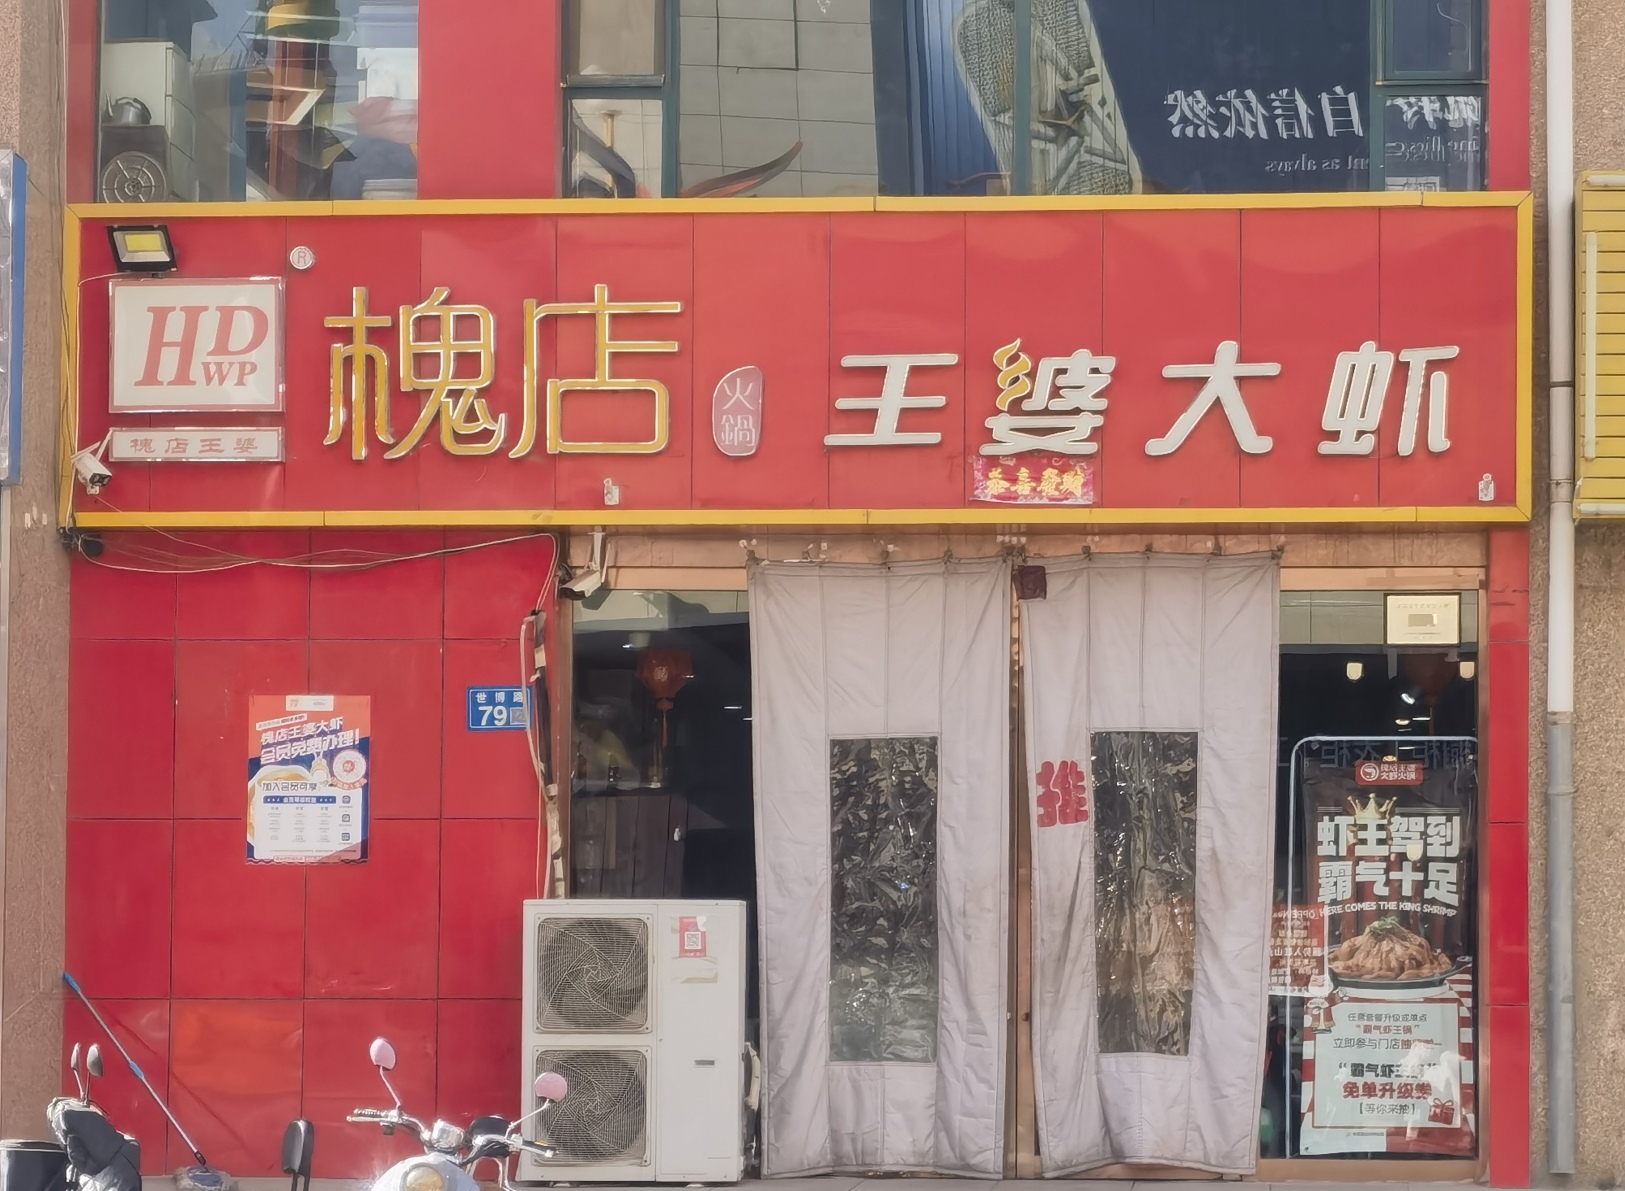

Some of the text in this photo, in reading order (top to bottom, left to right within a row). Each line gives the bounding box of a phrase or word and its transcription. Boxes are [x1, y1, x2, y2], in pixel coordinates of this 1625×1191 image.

[134, 304, 269, 388] HD
[201, 361, 258, 388] WP
[322, 282, 684, 461] 槐店
[822, 337, 1461, 457] 王婆大虾
[129, 437, 258, 455] 槐店王婆
[478, 705, 507, 726] 79
[1036, 760, 1089, 828] 推
[1317, 815, 1460, 858] 虾王驾到
[1317, 860, 1459, 907] 霸气十足
[1319, 901, 1458, 917] HERE COMES THE KING SHRIMP
